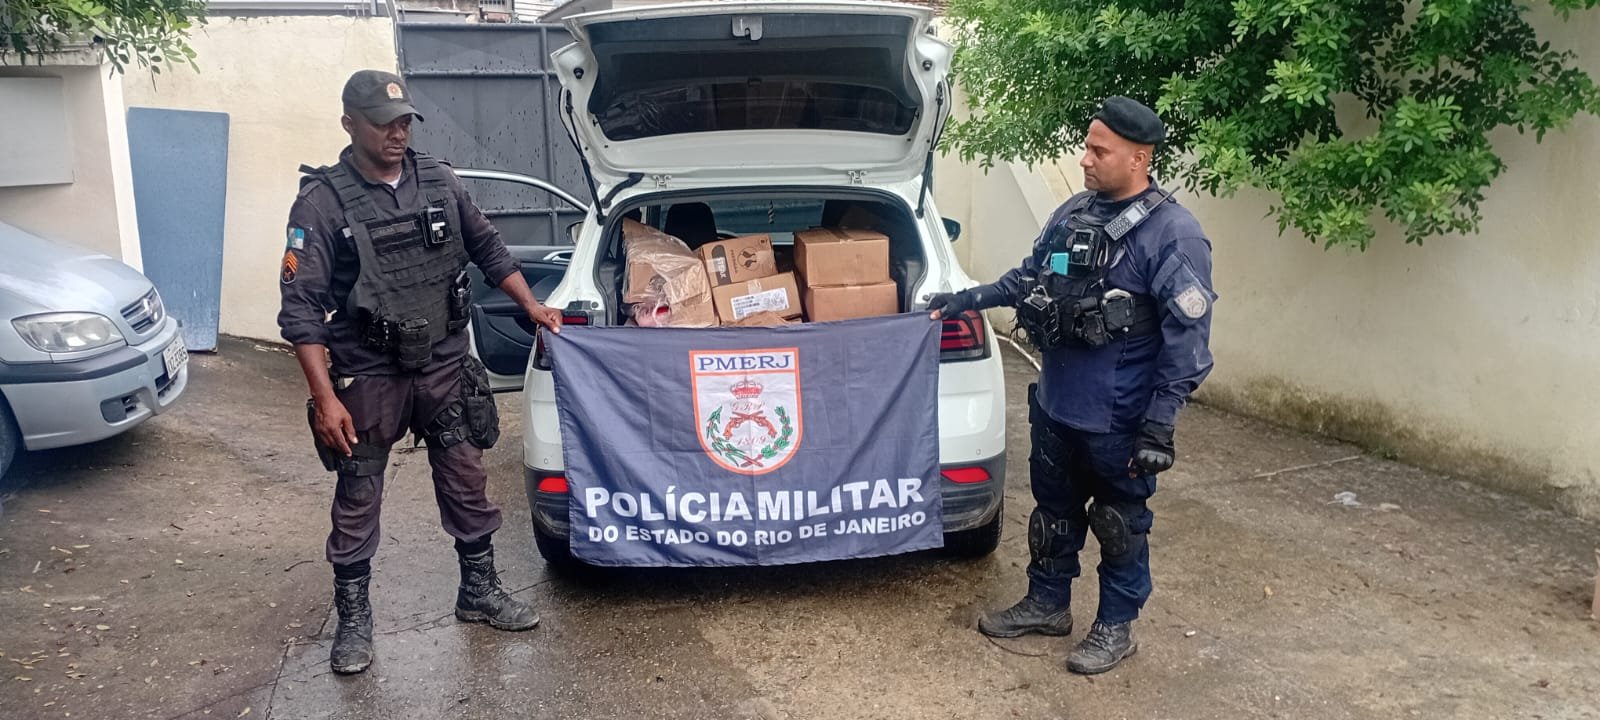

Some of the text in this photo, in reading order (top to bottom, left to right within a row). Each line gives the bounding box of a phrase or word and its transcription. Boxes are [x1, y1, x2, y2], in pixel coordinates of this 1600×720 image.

[698, 355, 791, 370] PMERJ
[585, 478, 924, 522] POLÍCIA MILITAR
[588, 511, 926, 547] DO ESTADO DO RIO DE JANEIRO
